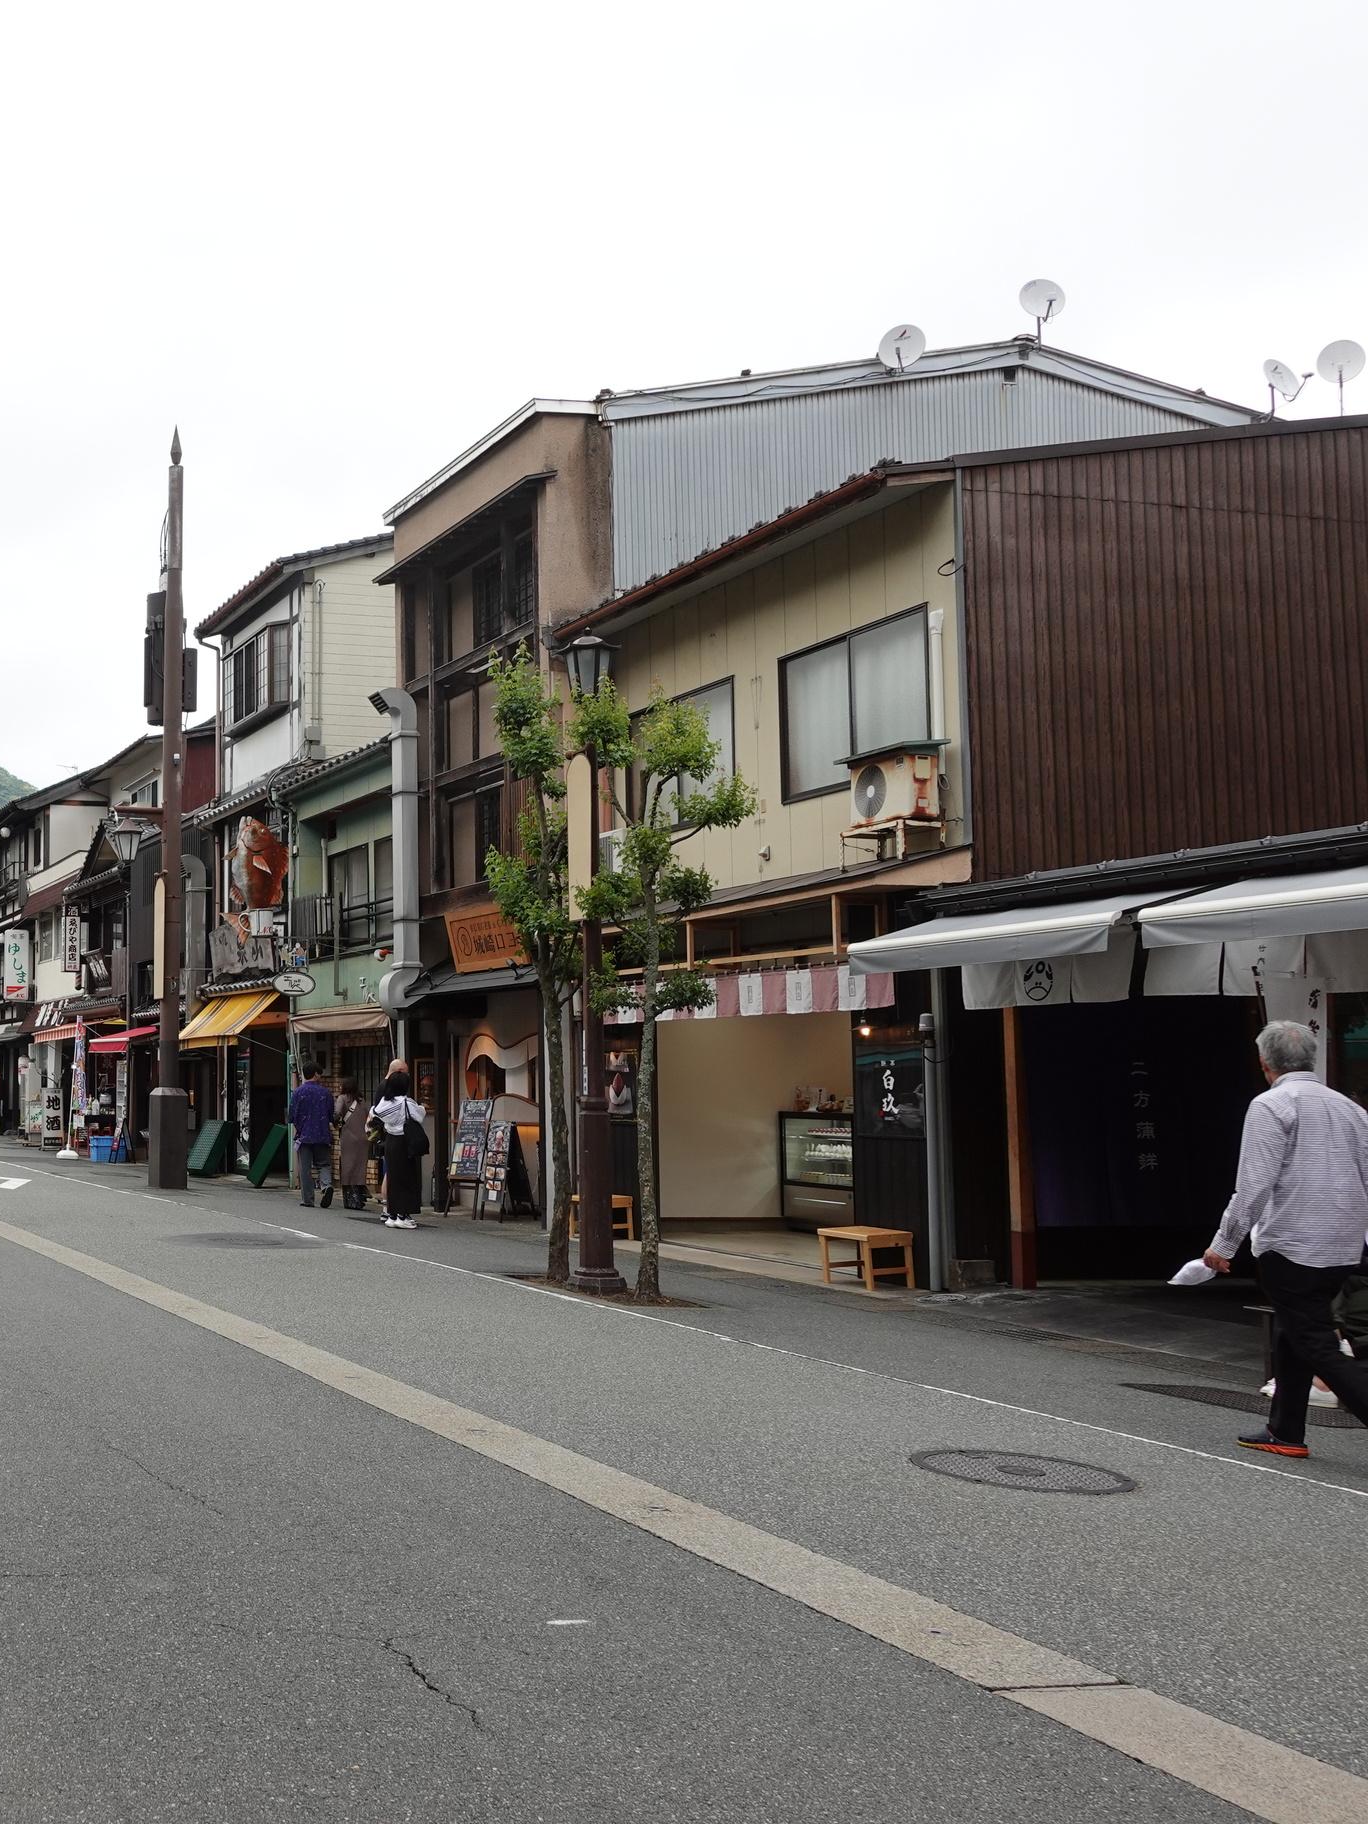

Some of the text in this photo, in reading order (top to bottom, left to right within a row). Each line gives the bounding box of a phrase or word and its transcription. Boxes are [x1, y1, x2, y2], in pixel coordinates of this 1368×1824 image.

[68, 906, 79, 916] 酒
[8, 943, 26, 983] ゆしま
[46, 1095, 61, 1131] 地酒
